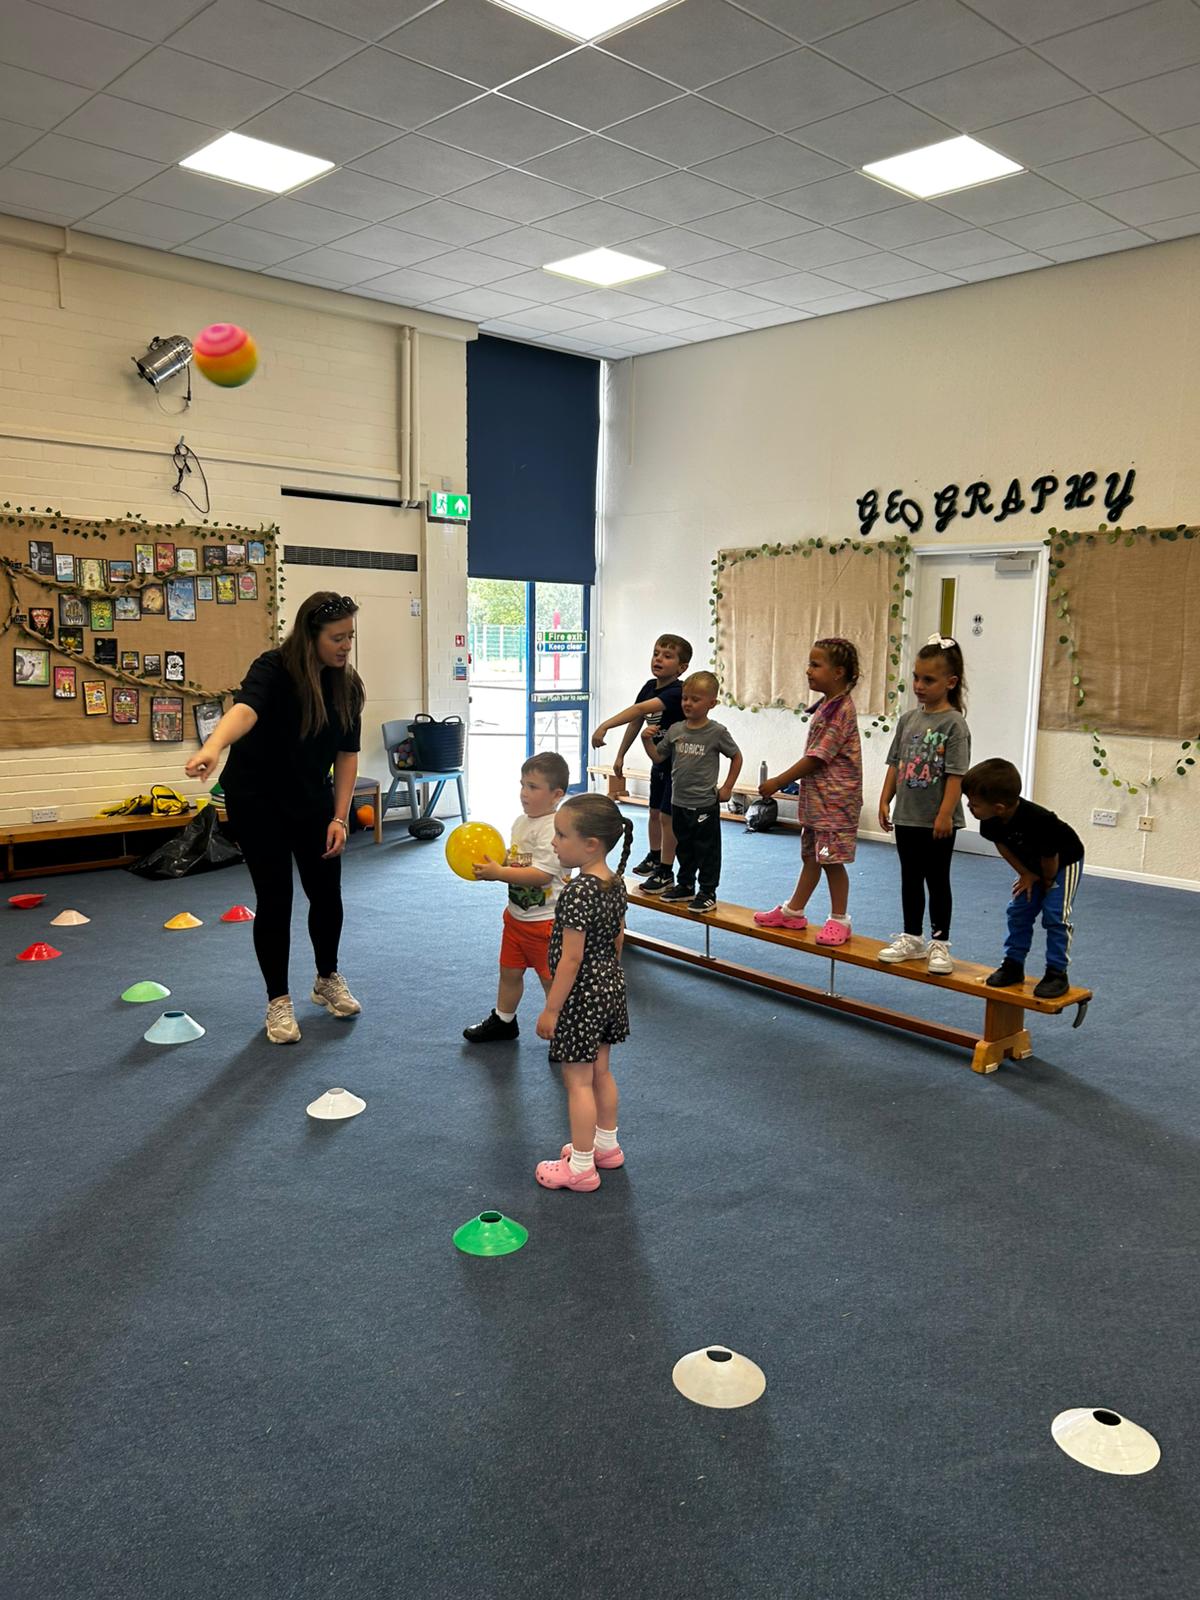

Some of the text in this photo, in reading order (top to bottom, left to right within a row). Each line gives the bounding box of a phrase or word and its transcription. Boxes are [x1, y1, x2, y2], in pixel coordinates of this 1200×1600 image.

[856, 468, 1136, 535] GEOGRAPHY
[548, 632, 583, 641] Fire exit
[548, 643, 582, 651] Keep clear
